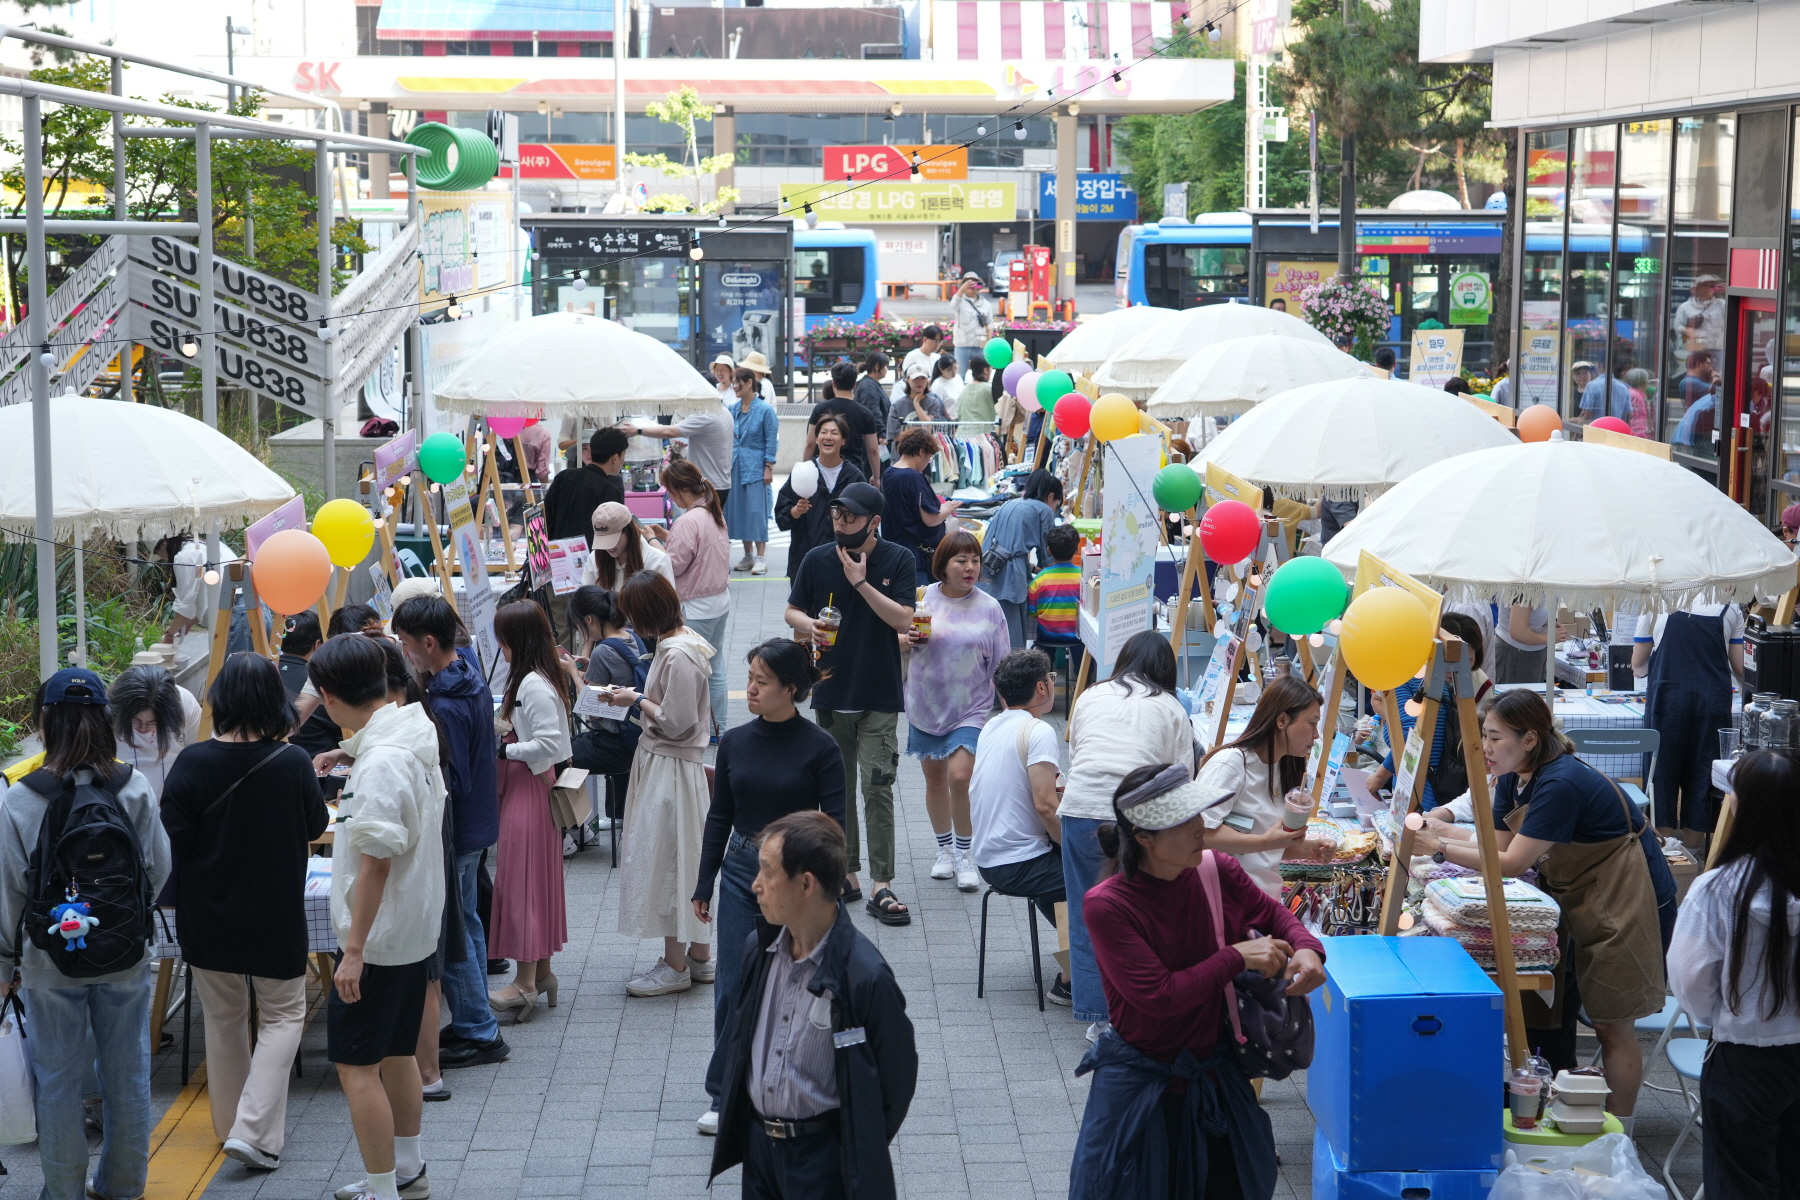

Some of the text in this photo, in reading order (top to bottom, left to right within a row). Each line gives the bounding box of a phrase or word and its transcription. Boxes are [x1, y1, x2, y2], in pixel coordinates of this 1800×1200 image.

[294, 61, 343, 93] SK
[1055, 65, 1133, 97] LPG
[520, 155, 551, 168] 사(주)
[842, 153, 889, 174] LPG
[818, 189, 872, 210] 친환경
[877, 191, 916, 210] LPG
[968, 188, 1004, 210] 환영
[1044, 179, 1134, 200] 세장입구
[602, 232, 639, 246] 수유역
[605, 246, 639, 254] Suyu Station
[76, 236, 116, 298] EPISODE
[50, 282, 75, 323] OWN
[78, 278, 117, 345] EPISODE
[53, 325, 77, 368] OWN
[80, 320, 119, 388] EPISODE
[1531, 338, 1552, 350] 무료
